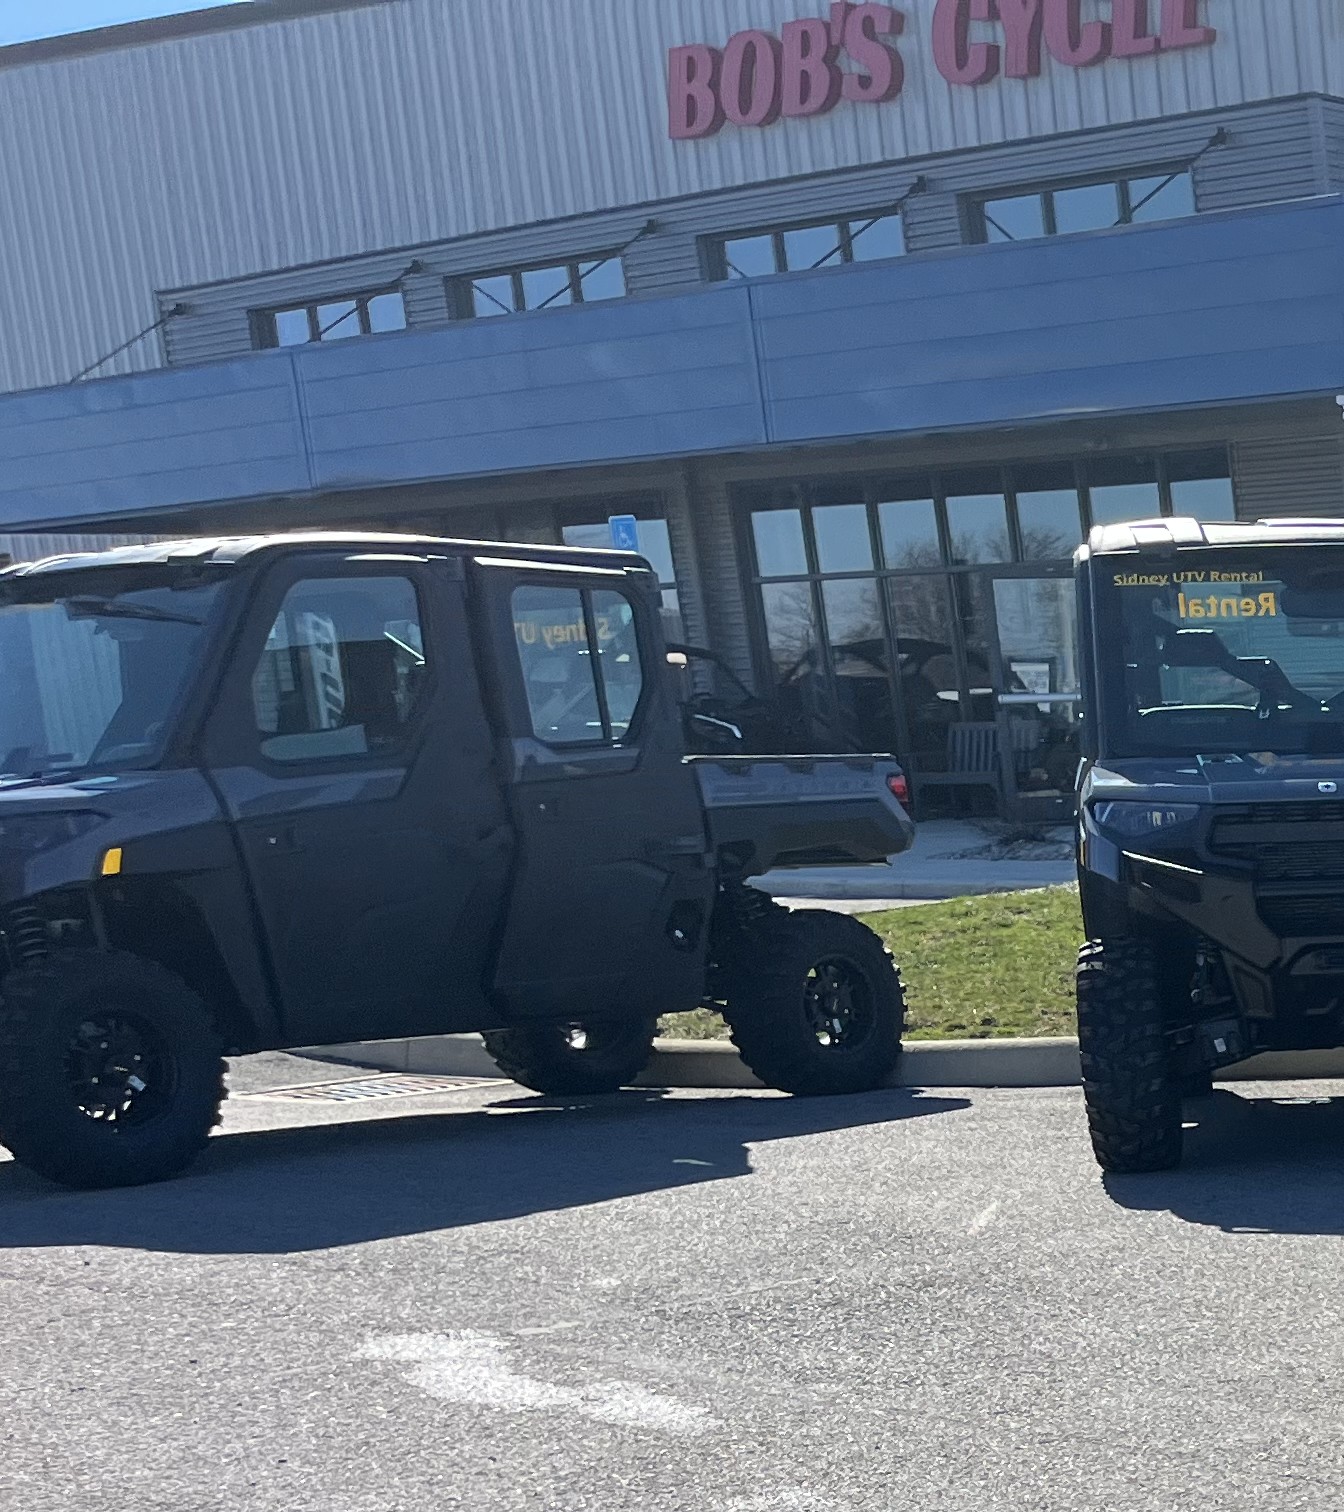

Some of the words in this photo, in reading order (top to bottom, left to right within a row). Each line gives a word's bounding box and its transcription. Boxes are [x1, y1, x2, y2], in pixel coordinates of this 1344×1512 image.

[669, 1, 904, 140] BOB'S
[1113, 573, 1168, 586] Sidney
[1172, 571, 1205, 583] UTV
[1210, 571, 1263, 583] Rental
